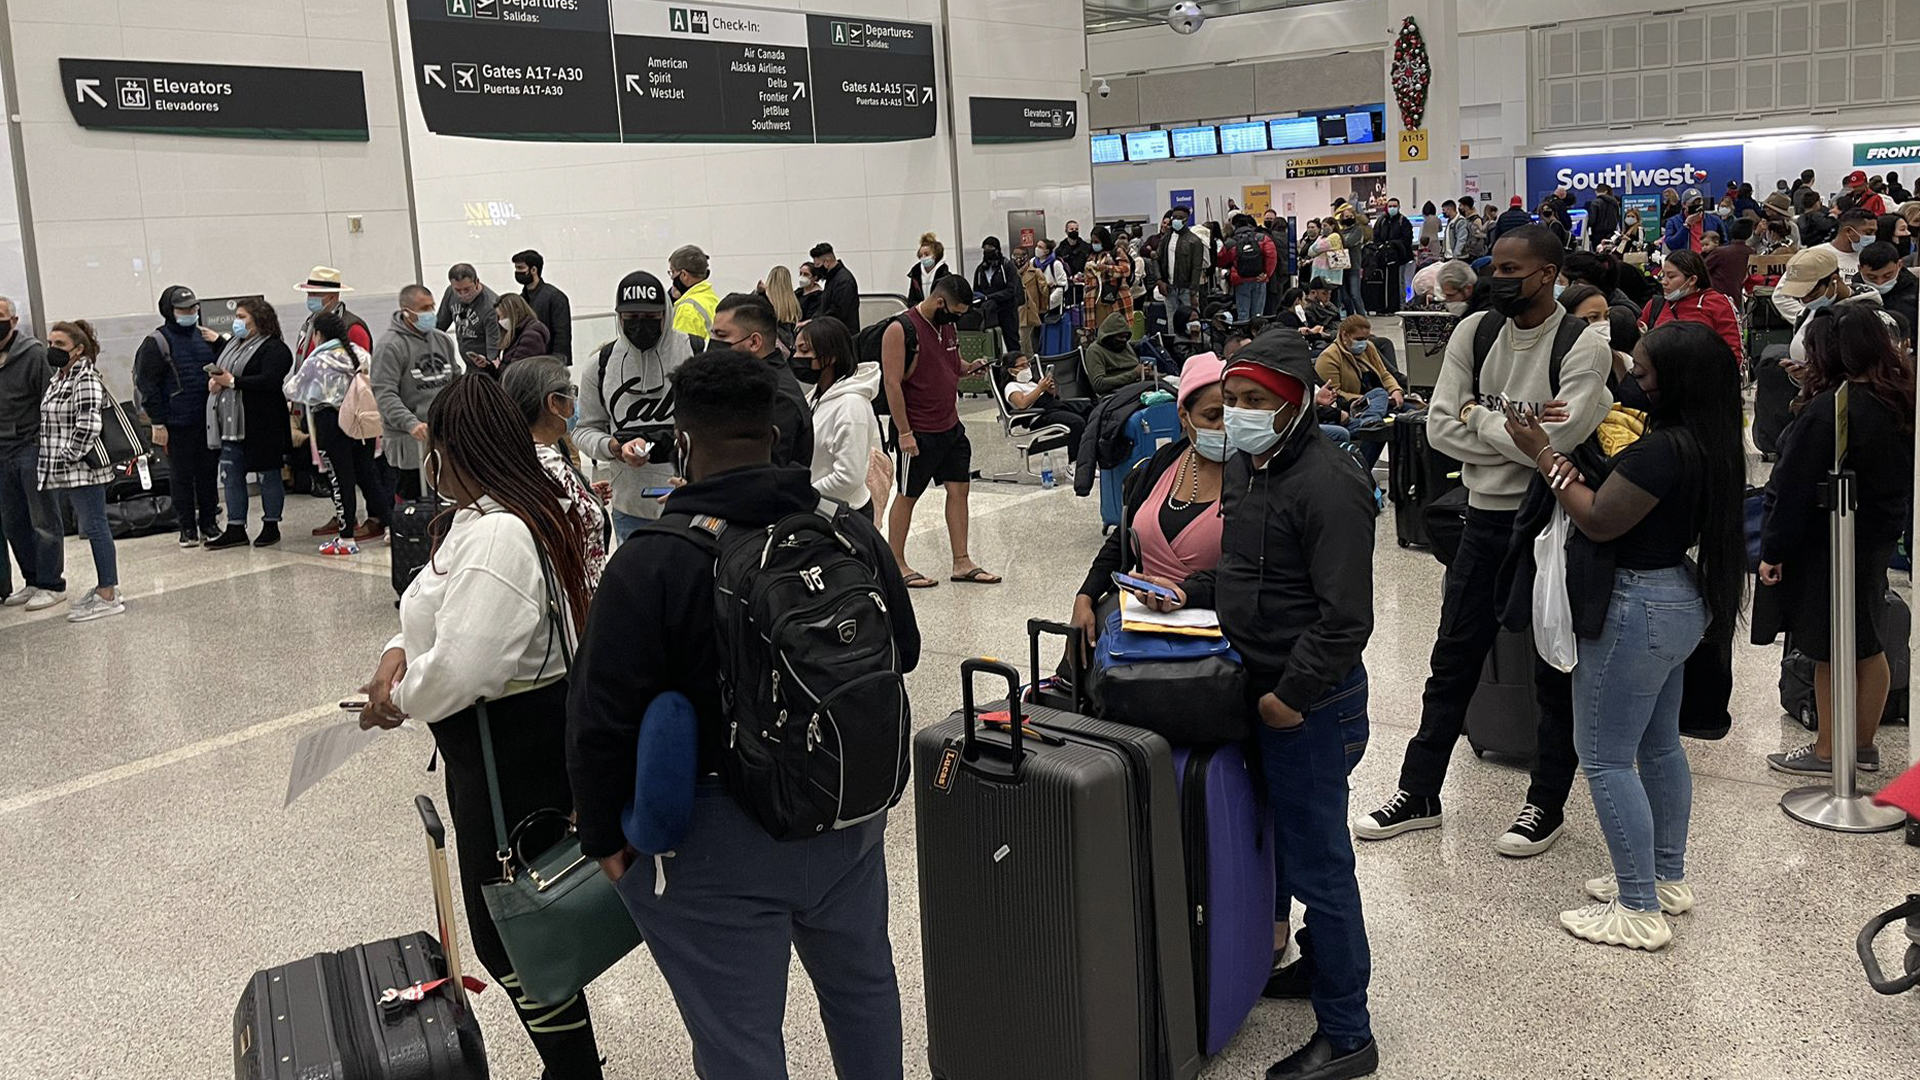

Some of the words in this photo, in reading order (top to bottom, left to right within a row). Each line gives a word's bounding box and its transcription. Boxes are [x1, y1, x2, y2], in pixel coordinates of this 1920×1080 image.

[503, 11, 540, 22] Salidas:
[674, 10, 685, 30] A
[712, 17, 760, 32] Check-In:
[835, 24, 845, 42] A
[865, 24, 914, 38] Departures:
[866, 39, 890, 49] Salidas:
[744, 47, 755, 59] Air
[757, 48, 786, 60] Canada
[647, 56, 688, 69] American
[730, 61, 756, 72] Alaska
[758, 62, 787, 75] Airlines
[482, 64, 522, 79] Gates
[525, 66, 583, 81] A17-A30
[649, 71, 672, 86] Spirit
[153, 78, 232, 95] Elevators
[767, 77, 788, 88] Delta
[841, 80, 867, 93] Gates
[869, 82, 901, 94] A1-A15
[483, 83, 520, 95] Puertas
[522, 84, 563, 96] A17-A30
[650, 87, 685, 100] WestJet
[758, 91, 788, 103] Frontier
[856, 96, 879, 106] Puertas
[880, 97, 902, 106] A1-A15
[155, 99, 219, 112] Elevadores
[762, 104, 790, 118] jetBlue
[1023, 108, 1051, 117] Elevators
[751, 119, 791, 131] Southwest
[1402, 133, 1424, 143] A1-15
[1307, 168, 1328, 176] Skyway
[1557, 163, 1695, 190] Southwest
[623, 286, 657, 300] KING
